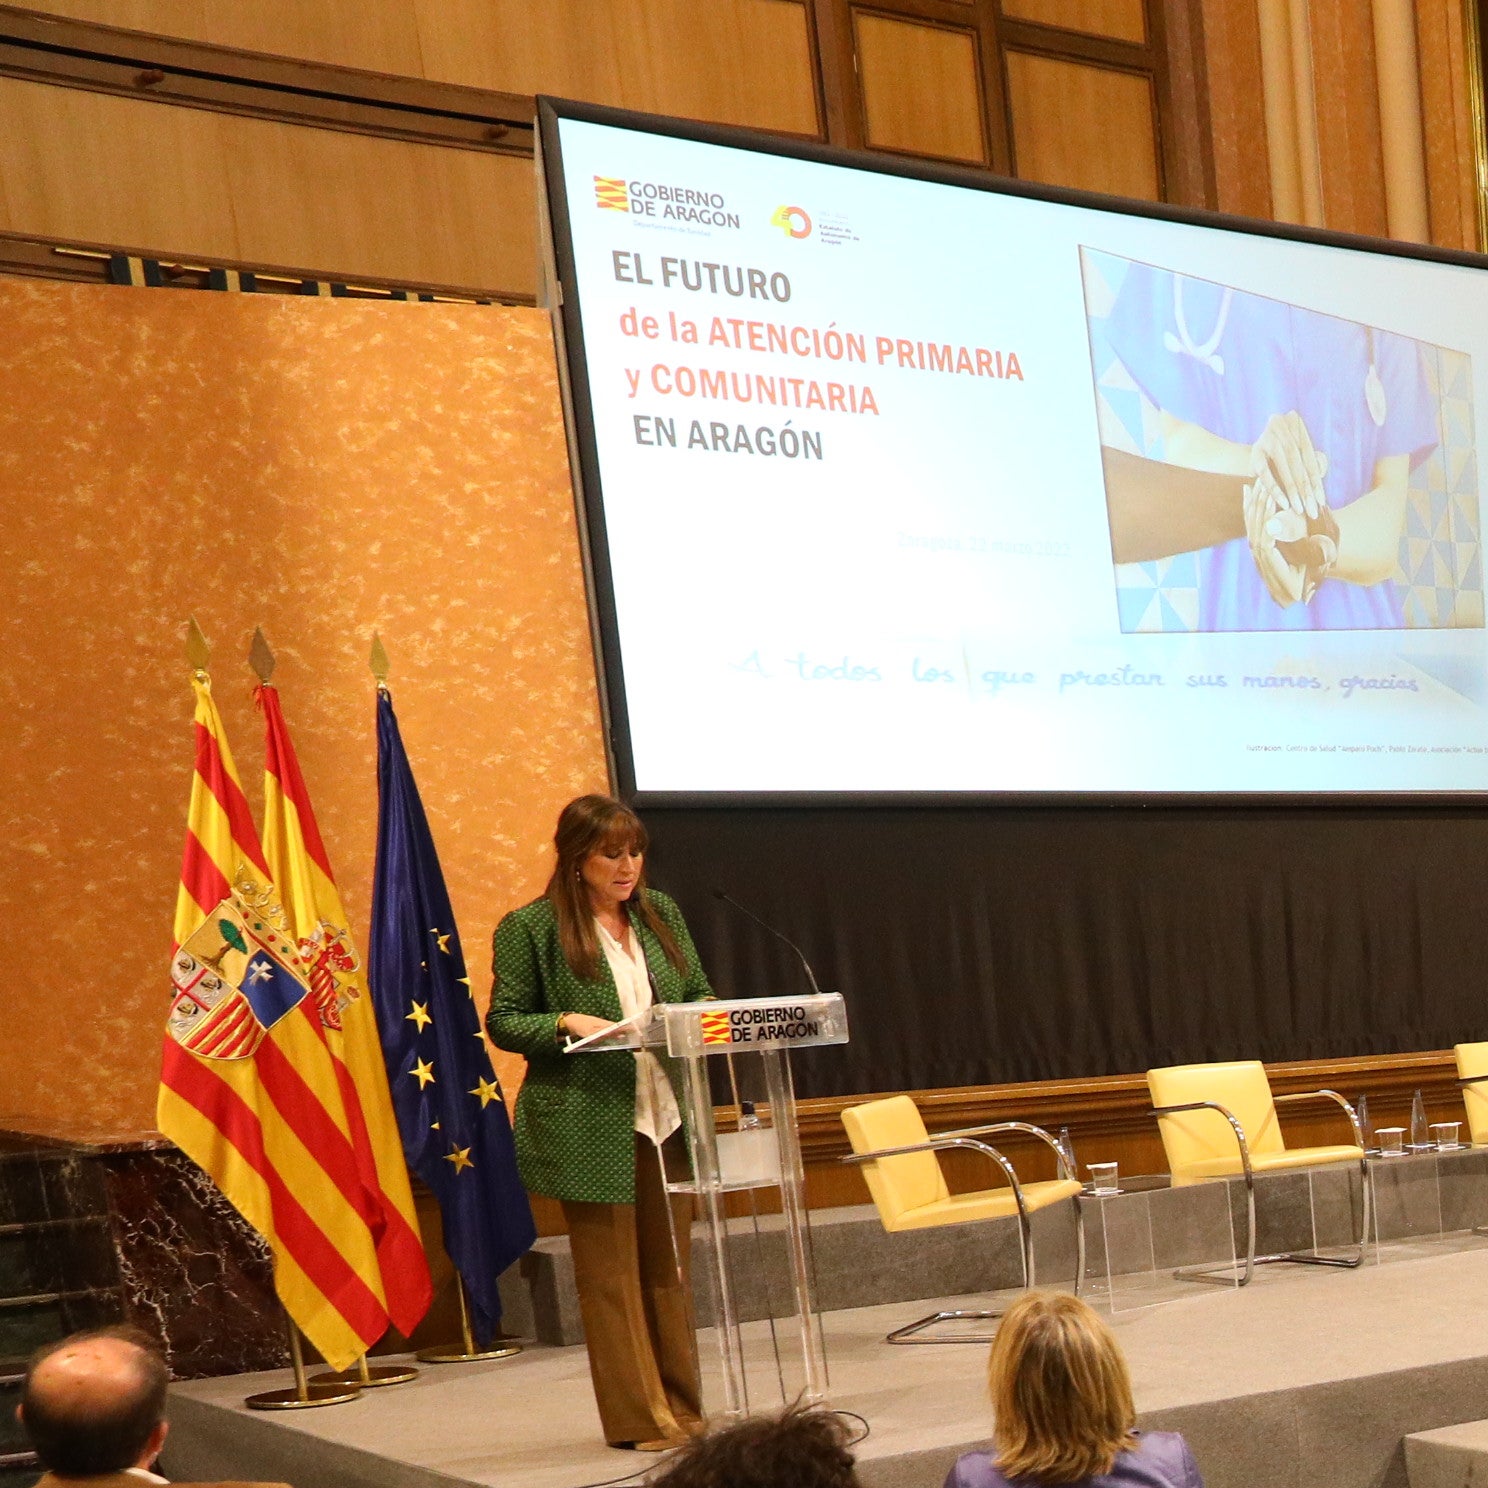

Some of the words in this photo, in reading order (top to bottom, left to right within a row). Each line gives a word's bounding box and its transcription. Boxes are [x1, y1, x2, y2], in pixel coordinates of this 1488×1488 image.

[629, 181, 724, 209] GOBIERNO
[631, 198, 656, 217] DE
[663, 204, 740, 229] ARAGON
[612, 250, 653, 286] EL
[660, 257, 791, 302] FUTURO
[619, 307, 659, 339] de
[670, 311, 698, 344] la
[708, 316, 867, 363] ATENCIÓN
[876, 337, 1024, 381] PRIMARIA
[625, 367, 640, 398] y
[651, 363, 880, 415] COMUNITARIA
[633, 415, 677, 448] EN
[687, 420, 823, 460] ARAGÓN
[784, 652, 882, 684] todos
[912, 656, 955, 684] los
[981, 668, 1036, 695] que
[1186, 672, 1227, 689] sus
[1242, 672, 1330, 692] manos,
[1339, 673, 1420, 698] gracias
[730, 1006, 806, 1025] GOBIERNO
[731, 1027, 751, 1042] DE
[757, 1022, 818, 1041] ARAGON
